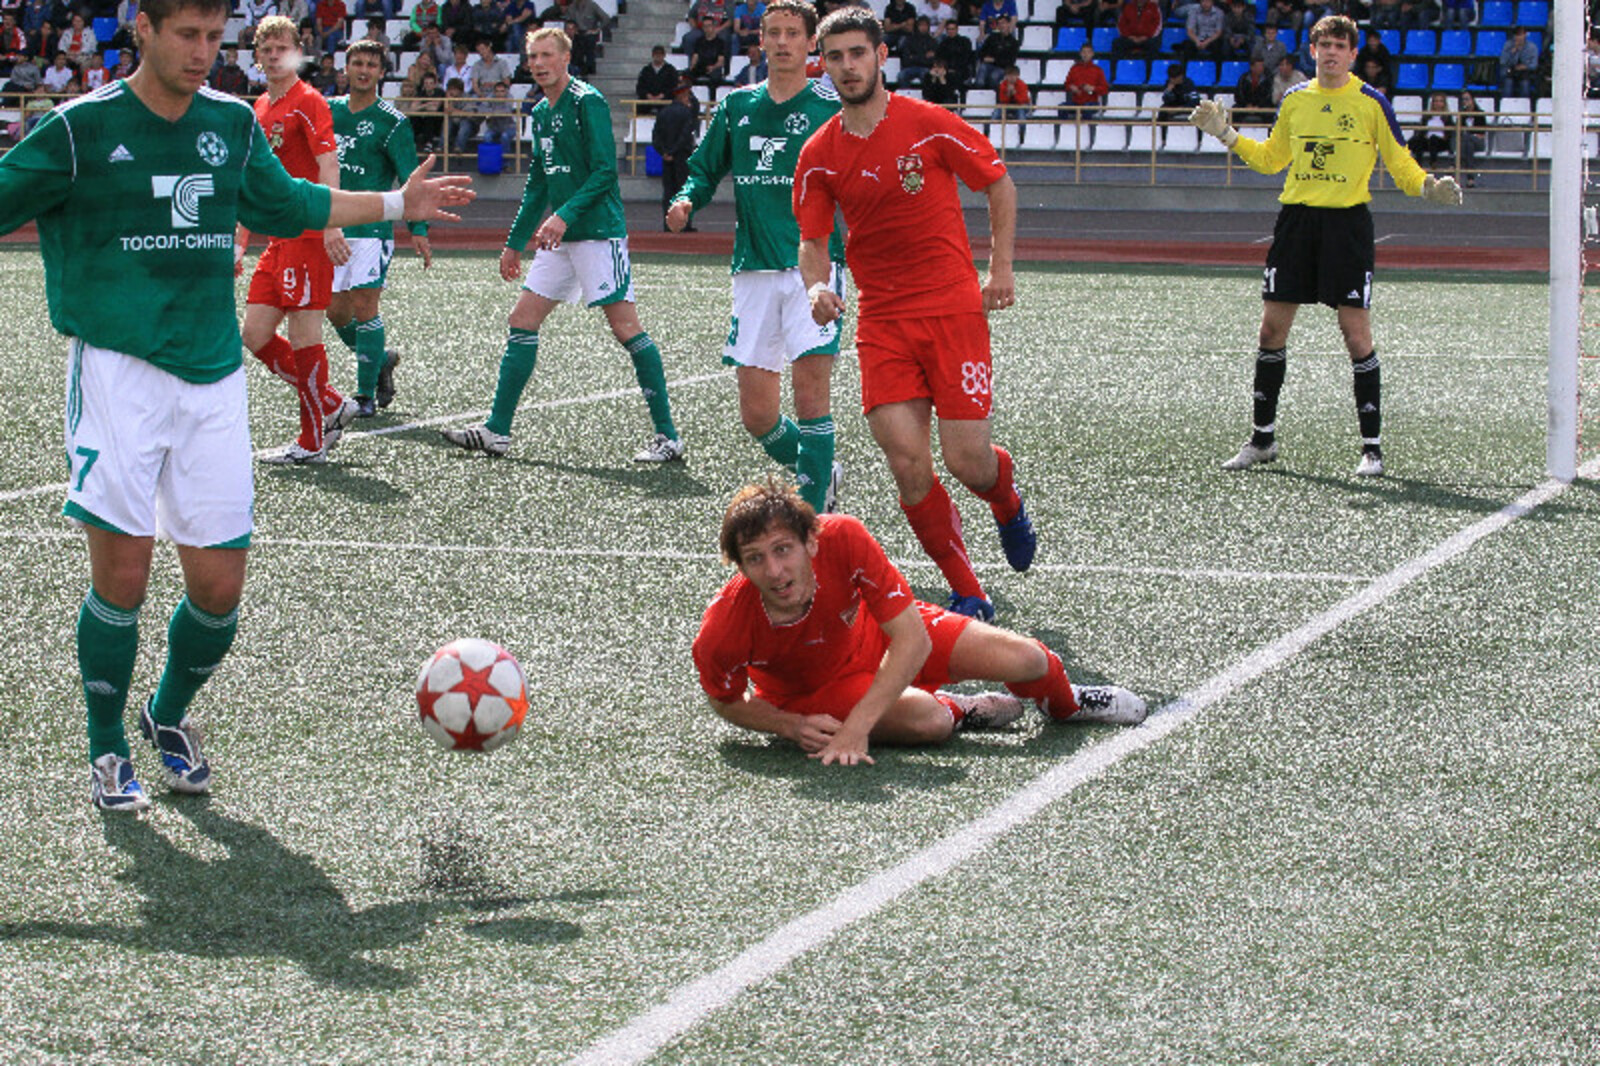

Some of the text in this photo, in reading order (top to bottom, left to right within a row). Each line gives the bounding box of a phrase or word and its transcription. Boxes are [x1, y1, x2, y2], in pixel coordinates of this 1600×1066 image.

[120, 233, 233, 251] ТОСОЛ-СИНТЕЗ
[283, 267, 297, 289] 9
[961, 361, 989, 395] 88
[74, 445, 100, 493] 7
